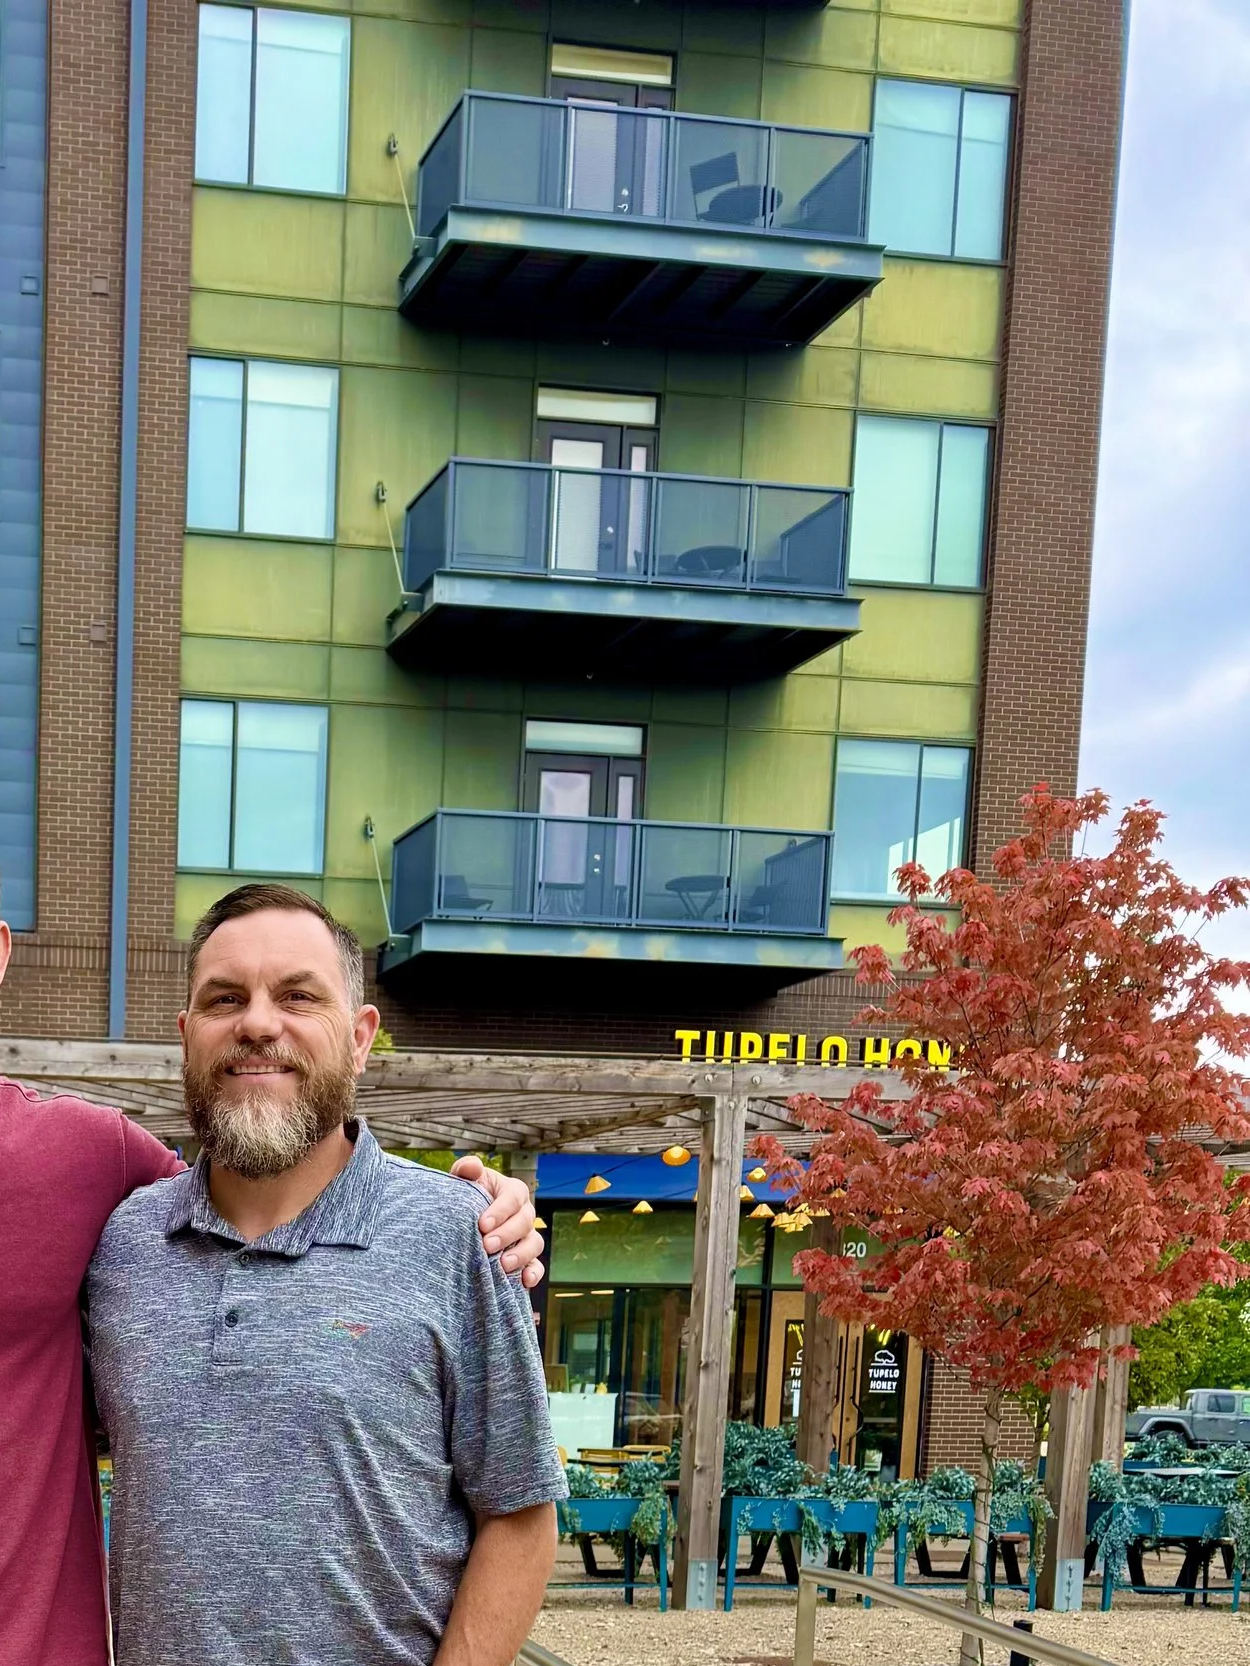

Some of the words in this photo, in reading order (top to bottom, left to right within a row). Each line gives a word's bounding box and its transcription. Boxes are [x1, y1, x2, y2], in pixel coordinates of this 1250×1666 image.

[864, 1036, 976, 1076] HON
[868, 1369, 900, 1379] TUPELO
[870, 1380, 898, 1390] HONEY
